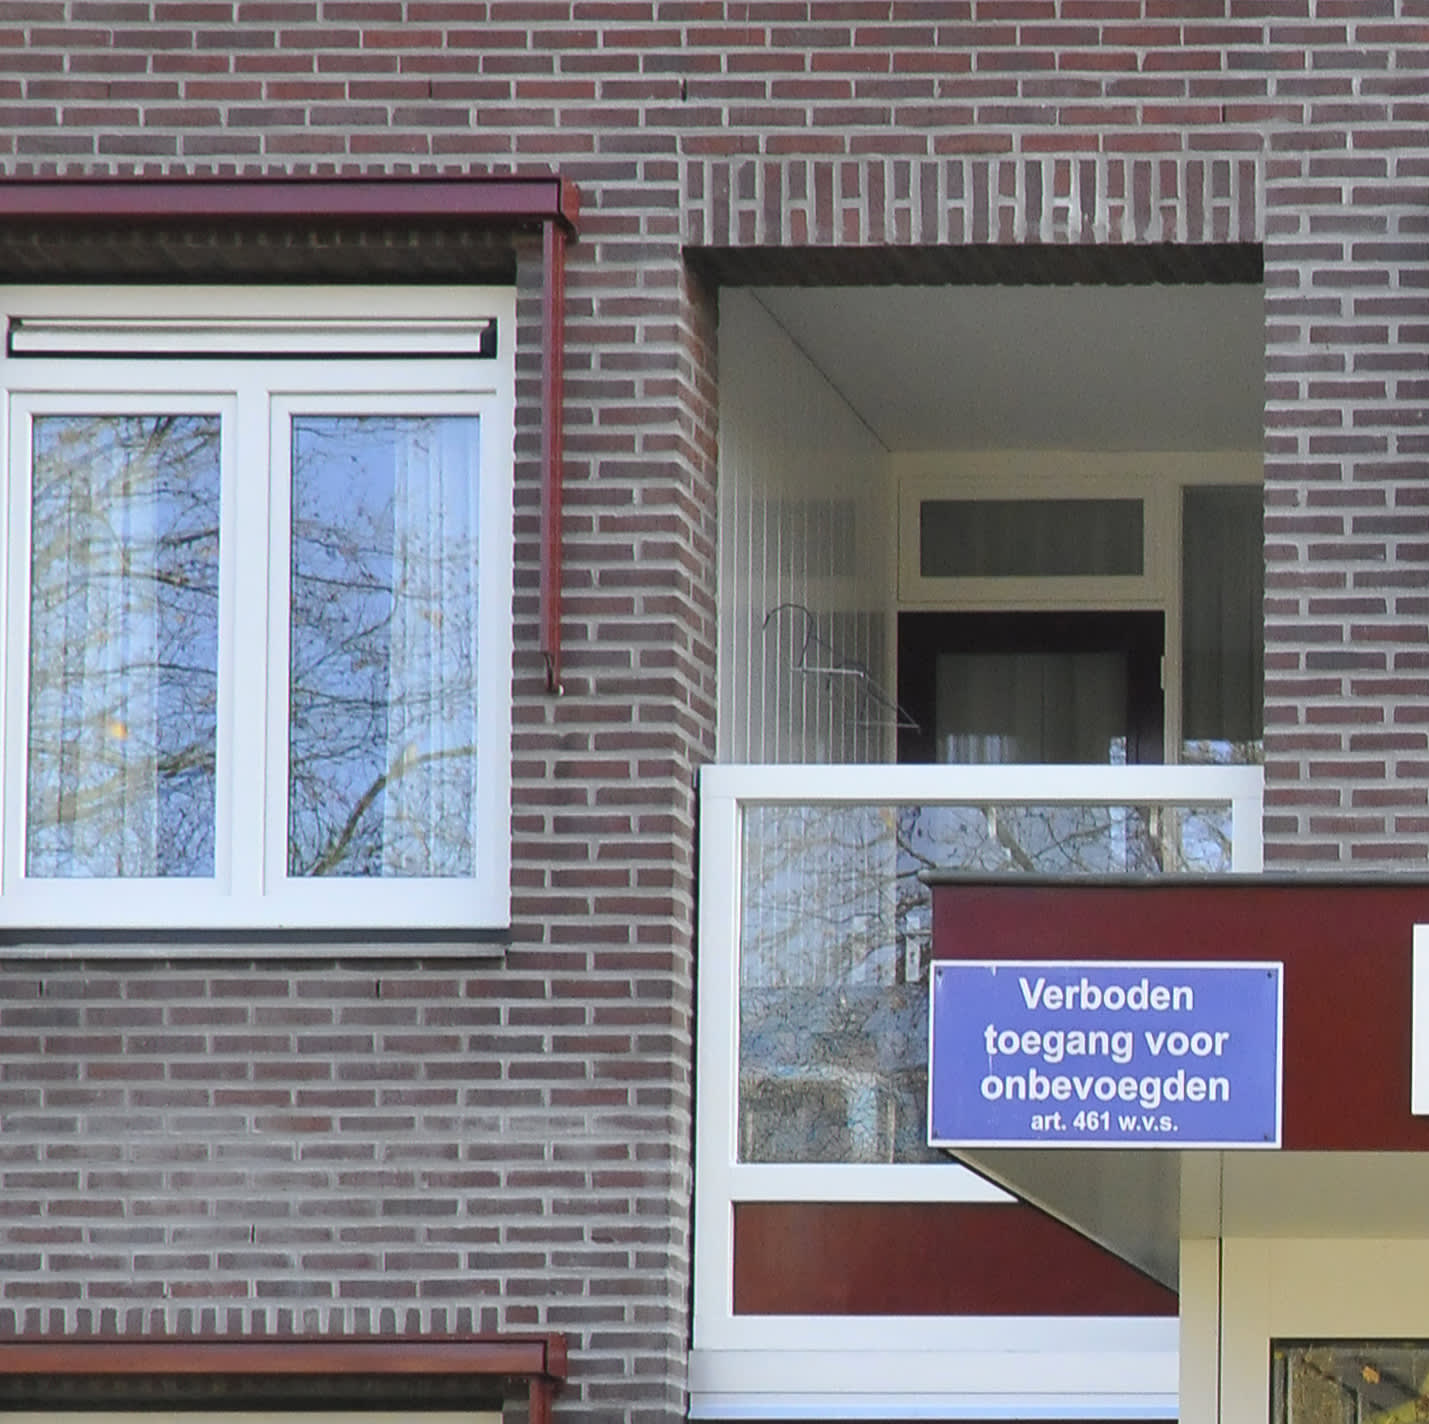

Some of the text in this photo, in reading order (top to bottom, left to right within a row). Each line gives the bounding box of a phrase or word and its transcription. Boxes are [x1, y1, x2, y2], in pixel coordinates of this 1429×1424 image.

[1019, 976, 1195, 1012] Verboden
[984, 1024, 1230, 1064] toegang voor
[981, 1068, 1231, 1109] onbevoegden
[1031, 1110, 1179, 1132] art. 461 w.v.s.
